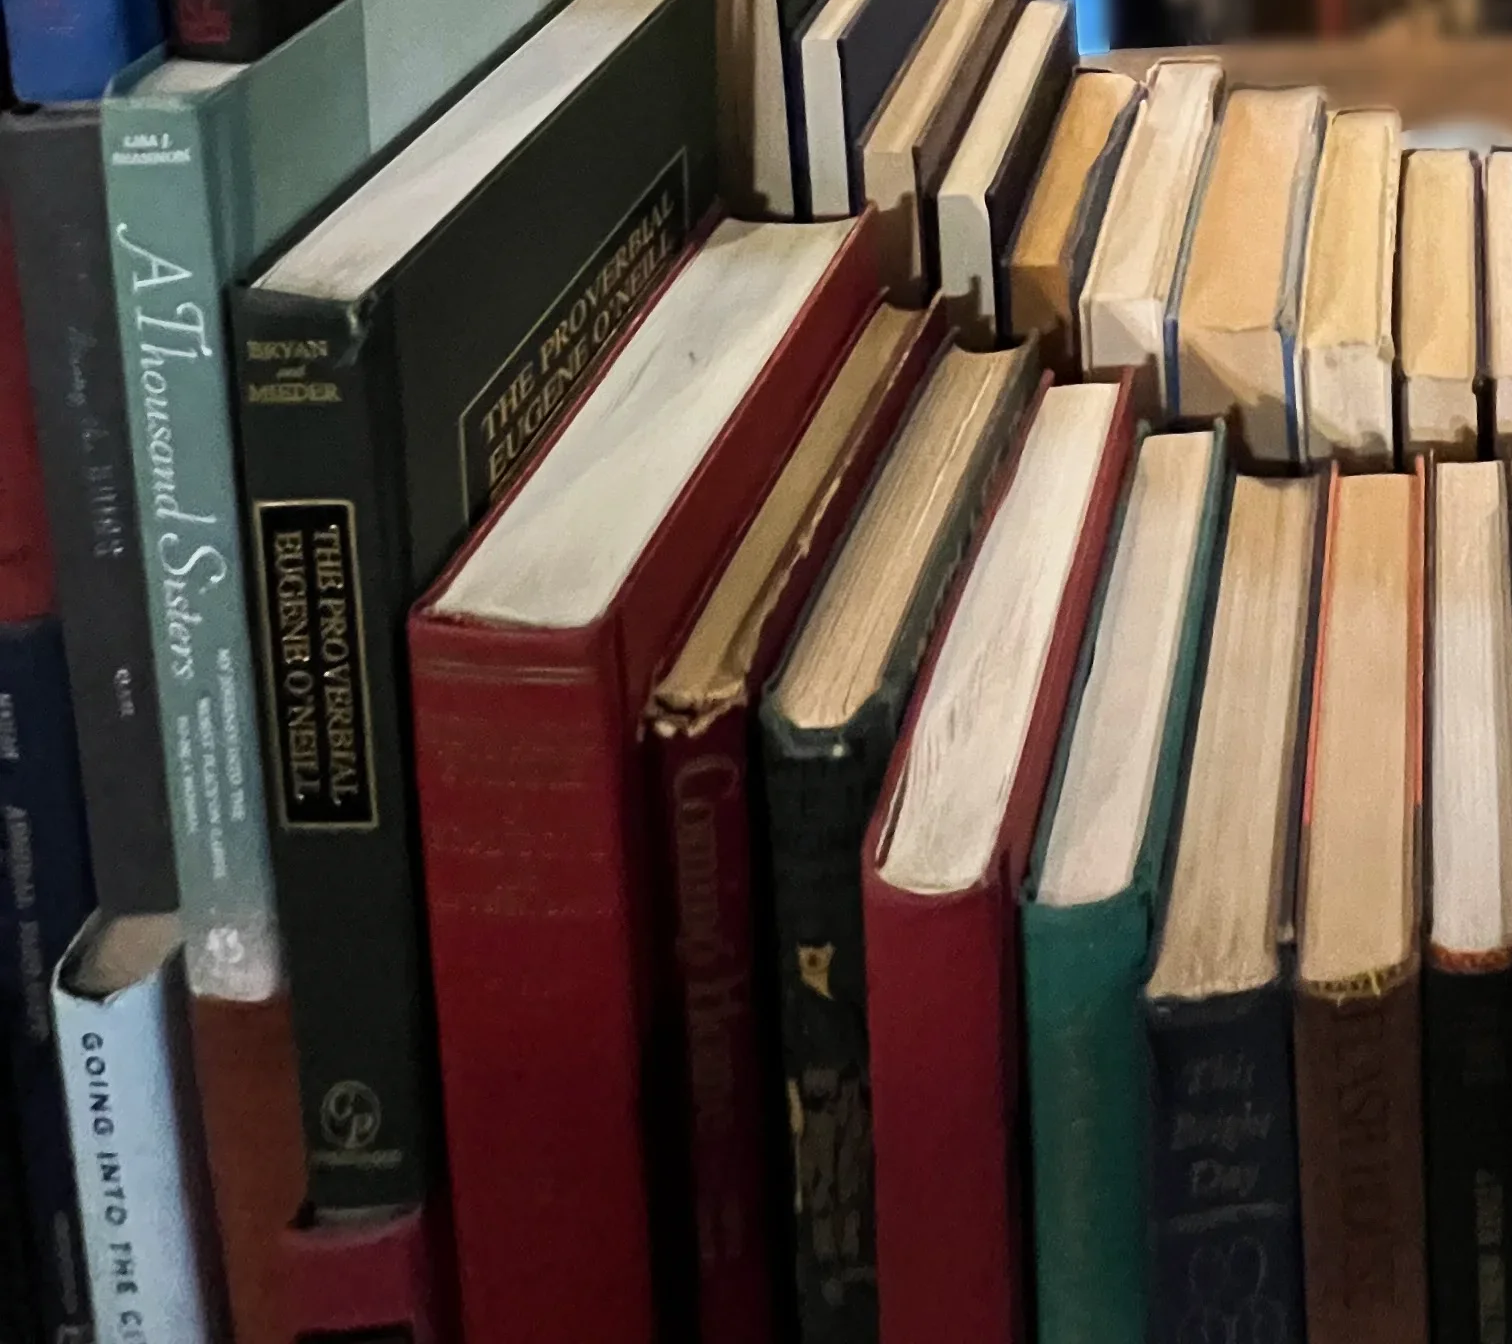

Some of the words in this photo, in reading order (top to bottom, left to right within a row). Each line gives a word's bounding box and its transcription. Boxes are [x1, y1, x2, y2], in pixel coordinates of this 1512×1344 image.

[116, 222, 194, 292] A
[248, 340, 328, 361] BRYAN
[484, 360, 536, 441] THE
[541, 190, 675, 368] PROVERBIAL
[136, 300, 216, 526] Thousand
[248, 382, 341, 402] MIEDER
[155, 531, 227, 680] Sisters
[273, 531, 312, 664] EUGENE
[312, 523, 343, 591] THE
[285, 671, 320, 802] O'NEILL
[317, 597, 358, 806] PROVERBIAL
[82, 1032, 115, 1139] GOING
[97, 1152, 127, 1226] INTO
[109, 1240, 137, 1296] THE
